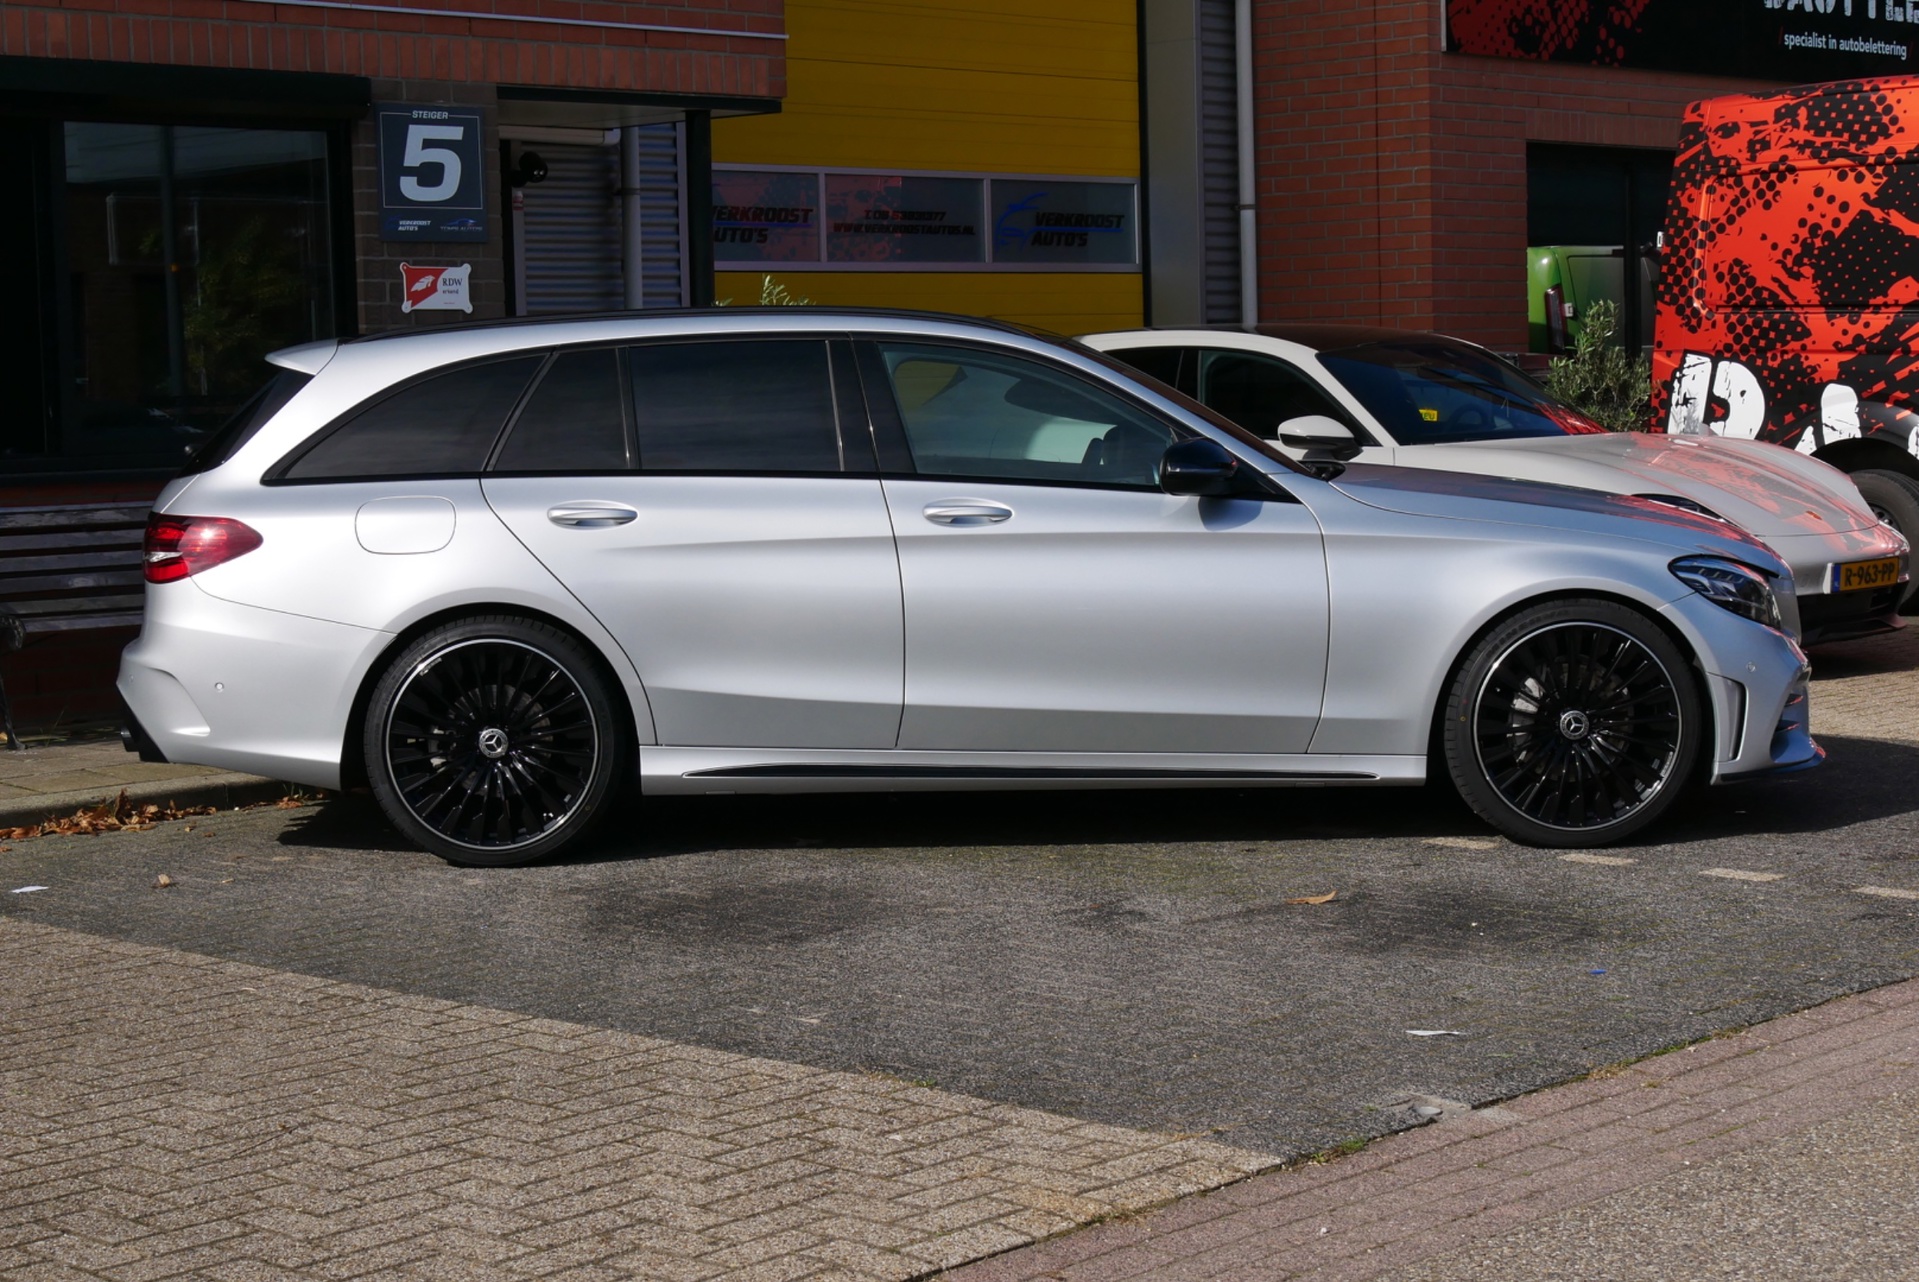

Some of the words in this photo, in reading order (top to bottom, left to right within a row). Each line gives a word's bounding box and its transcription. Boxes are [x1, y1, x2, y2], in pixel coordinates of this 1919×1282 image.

[1784, 32, 1827, 50] specialist
[1828, 34, 1837, 50] in
[1839, 36, 1907, 60] autobelettering
[412, 110, 449, 120] STEIGER
[400, 124, 464, 202] 5
[712, 206, 813, 224] ERKROOST
[1034, 212, 1125, 228] VERKROOST
[714, 228, 769, 243] UTO'S
[1031, 231, 1088, 247] AUTO'S
[442, 278, 463, 287] RDW
[1844, 562, 1896, 587] R-963-PP
